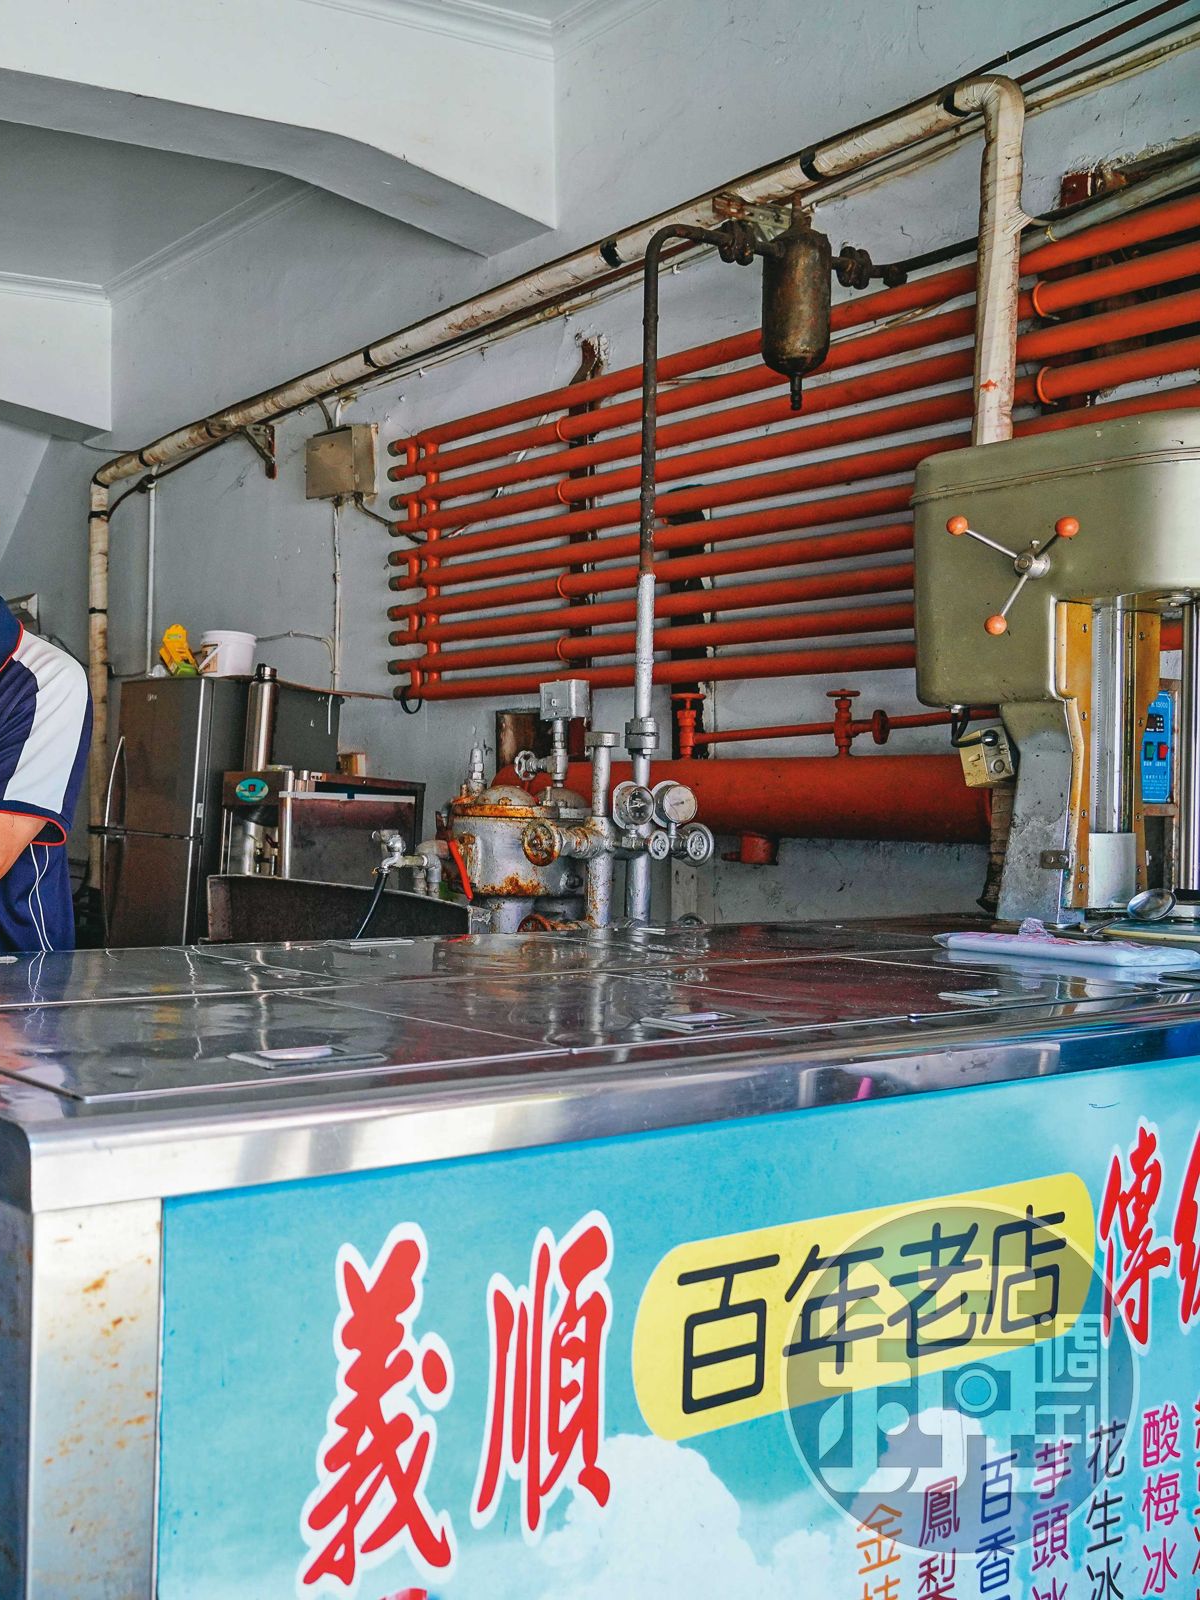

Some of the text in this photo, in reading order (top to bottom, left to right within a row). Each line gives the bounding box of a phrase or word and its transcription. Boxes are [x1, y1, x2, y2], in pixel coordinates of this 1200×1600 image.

[302, 1225, 611, 1586] 義順
[676, 1204, 1066, 1415] 百年老店
[974, 1453, 1018, 1600] 百香
[1085, 1419, 1127, 1600] 花生冰
[1142, 1404, 1182, 1596] 酸梅冰
